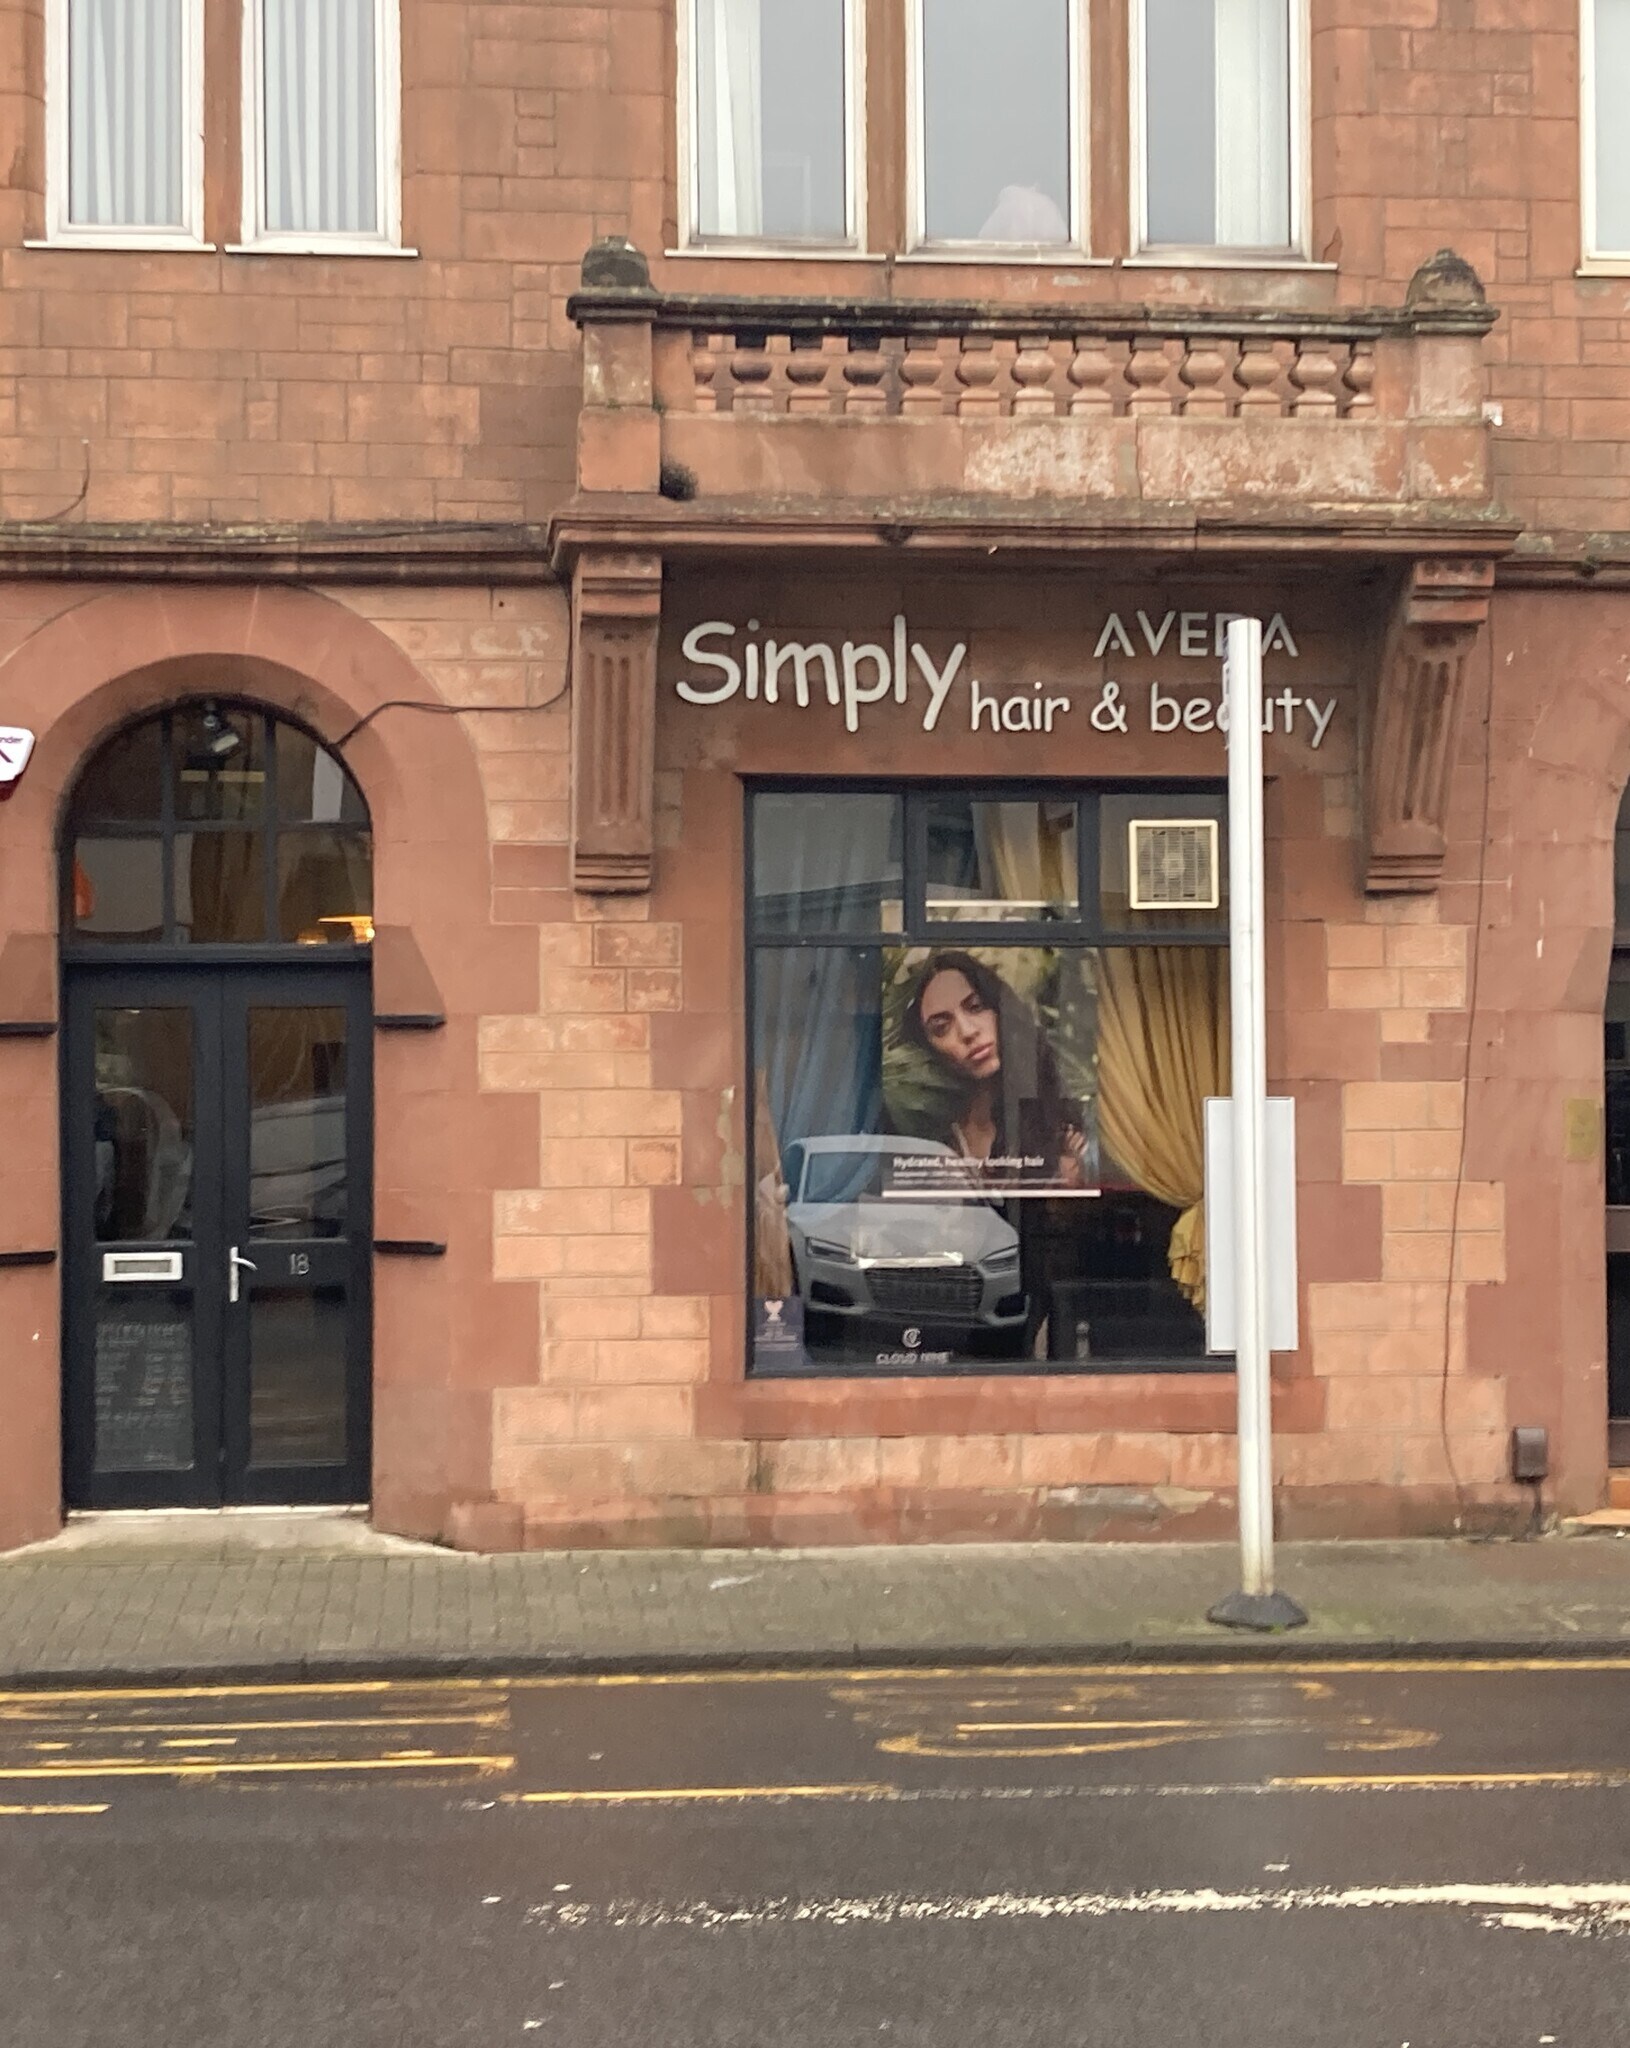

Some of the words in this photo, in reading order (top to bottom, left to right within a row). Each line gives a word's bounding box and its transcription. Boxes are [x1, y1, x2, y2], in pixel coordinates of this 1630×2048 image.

[676, 614, 966, 732] Simply
[970, 680, 1070, 733] hair
[1090, 681, 1128, 733] &
[985, 1156, 1023, 1169] looking
[1024, 1155, 1045, 1168] hair
